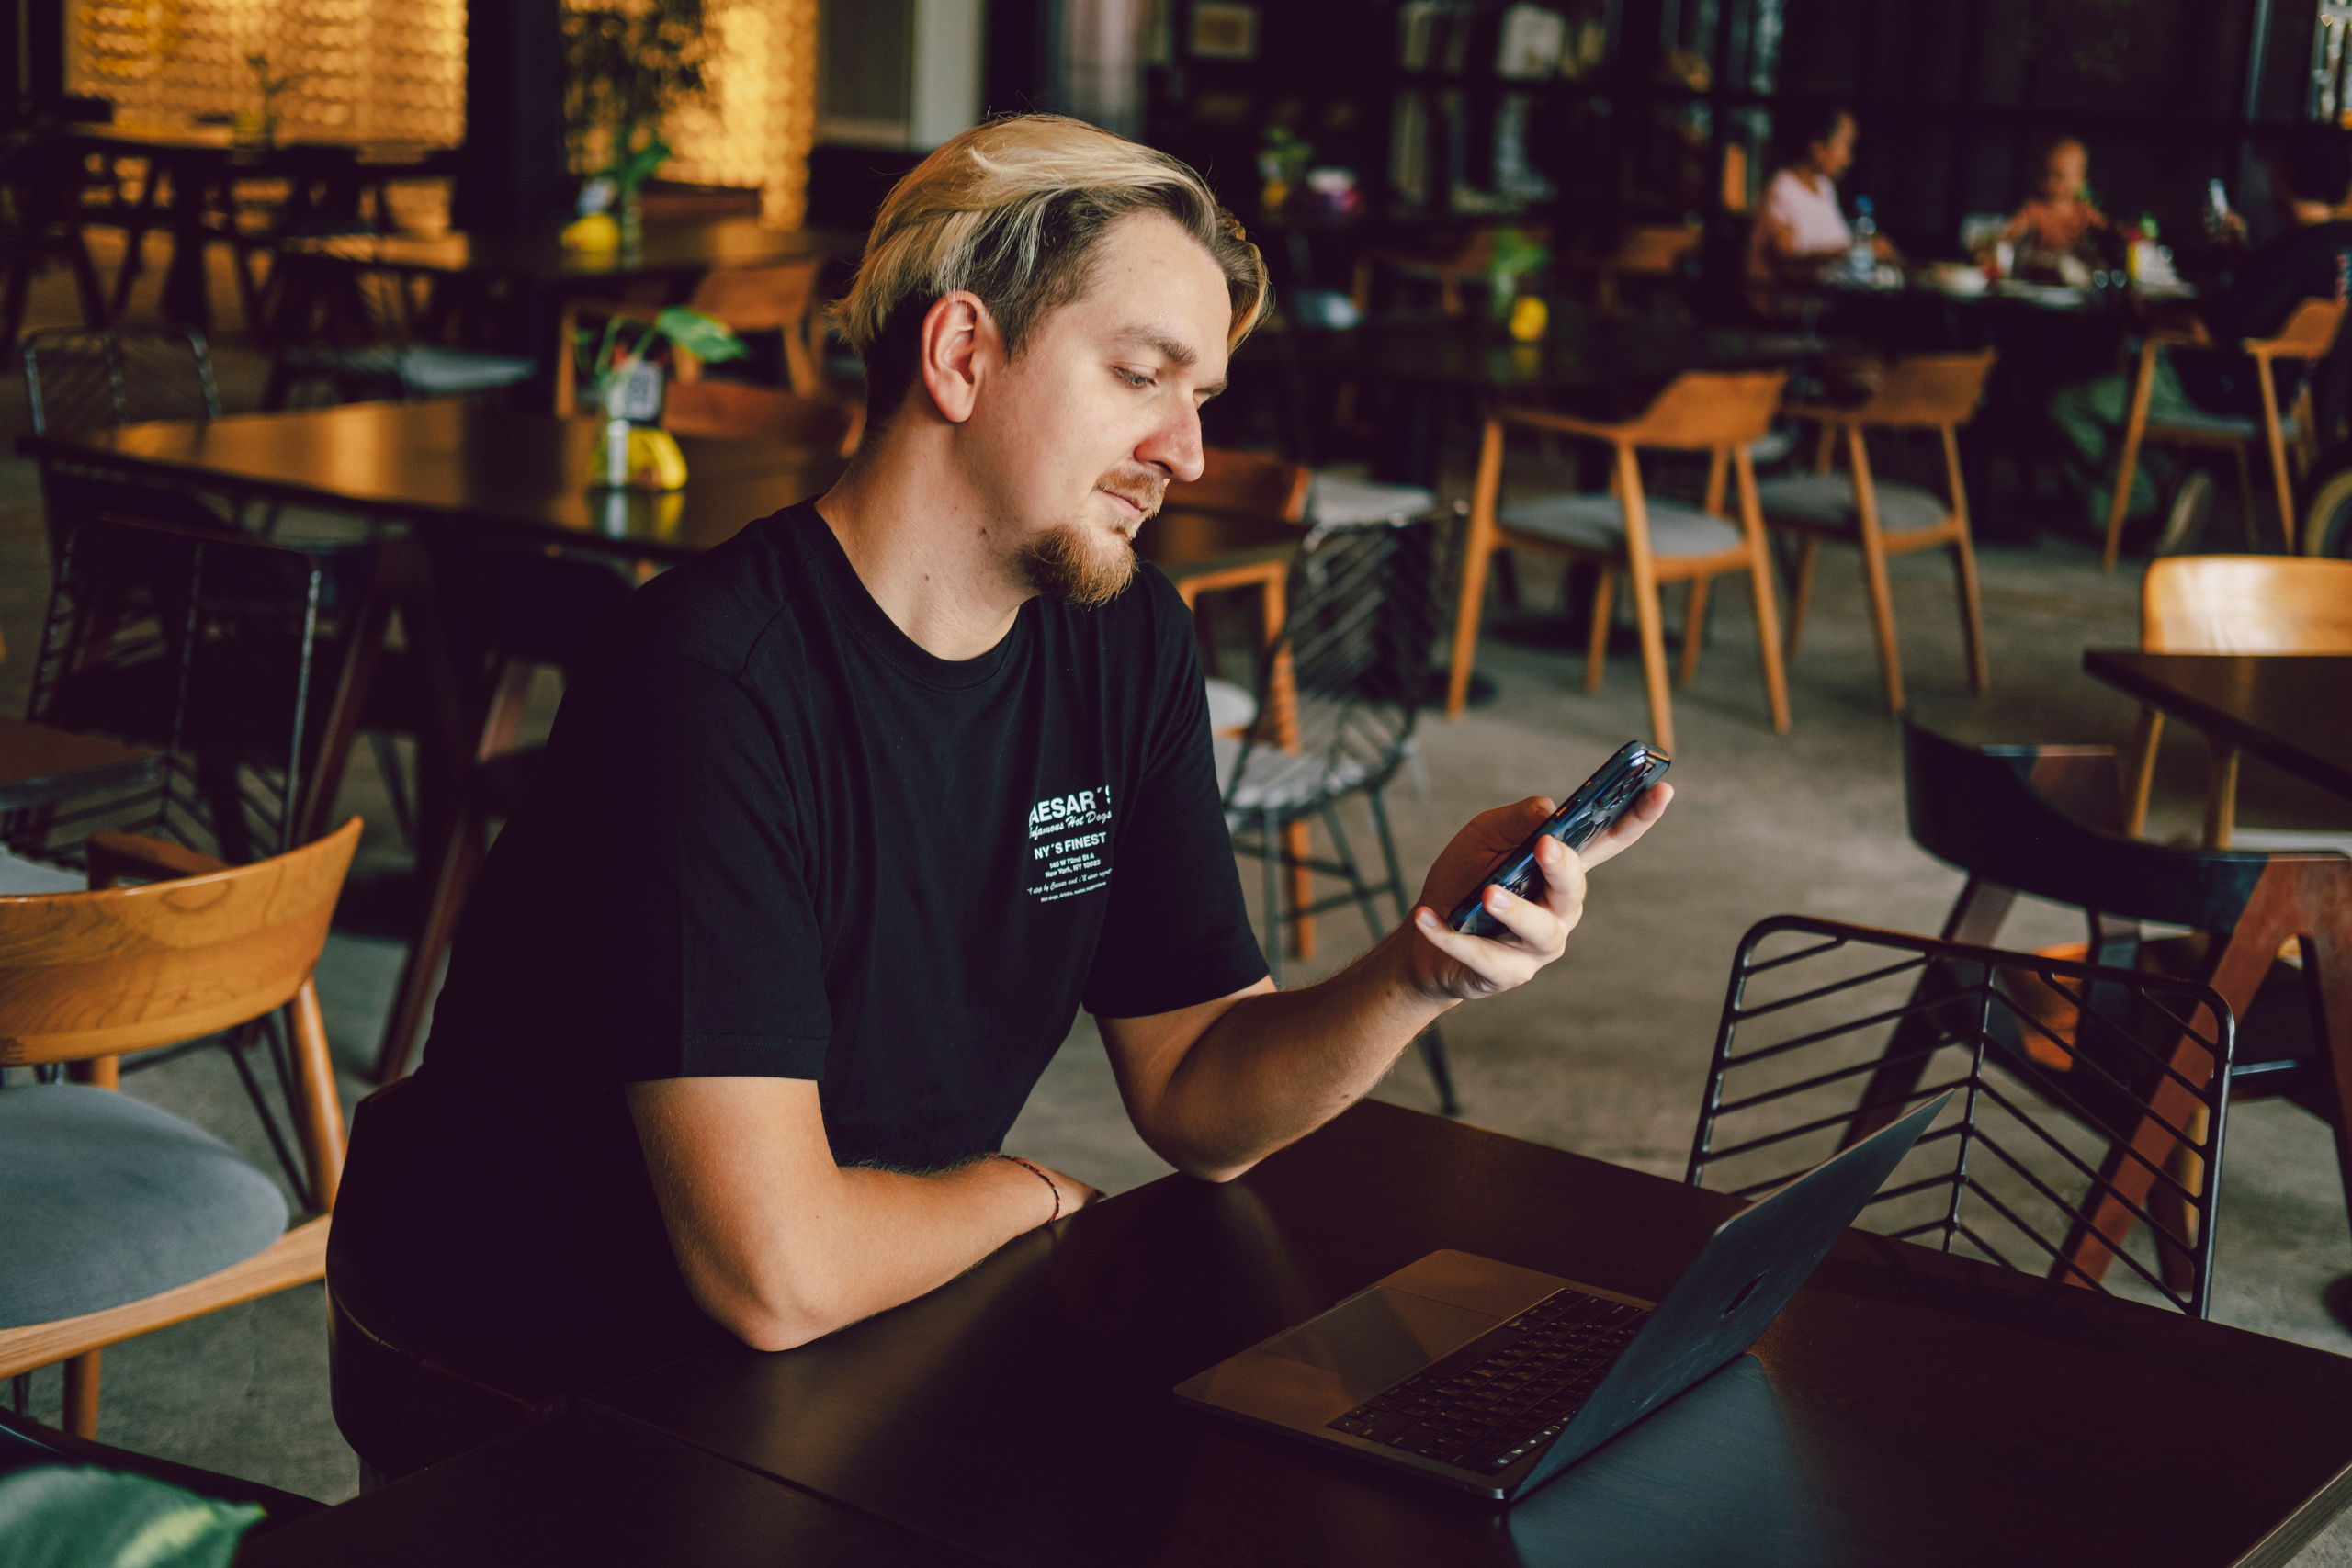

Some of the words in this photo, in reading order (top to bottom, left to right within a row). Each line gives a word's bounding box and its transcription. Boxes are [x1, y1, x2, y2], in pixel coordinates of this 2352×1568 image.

[1065, 815, 1084, 829] Hot
[1085, 810, 1112, 825] Dogs
[1034, 842, 1064, 860] NY'S
[1064, 831, 1107, 852] FINEST
[1045, 870, 1058, 878] New
[1072, 863, 1082, 872] NY
